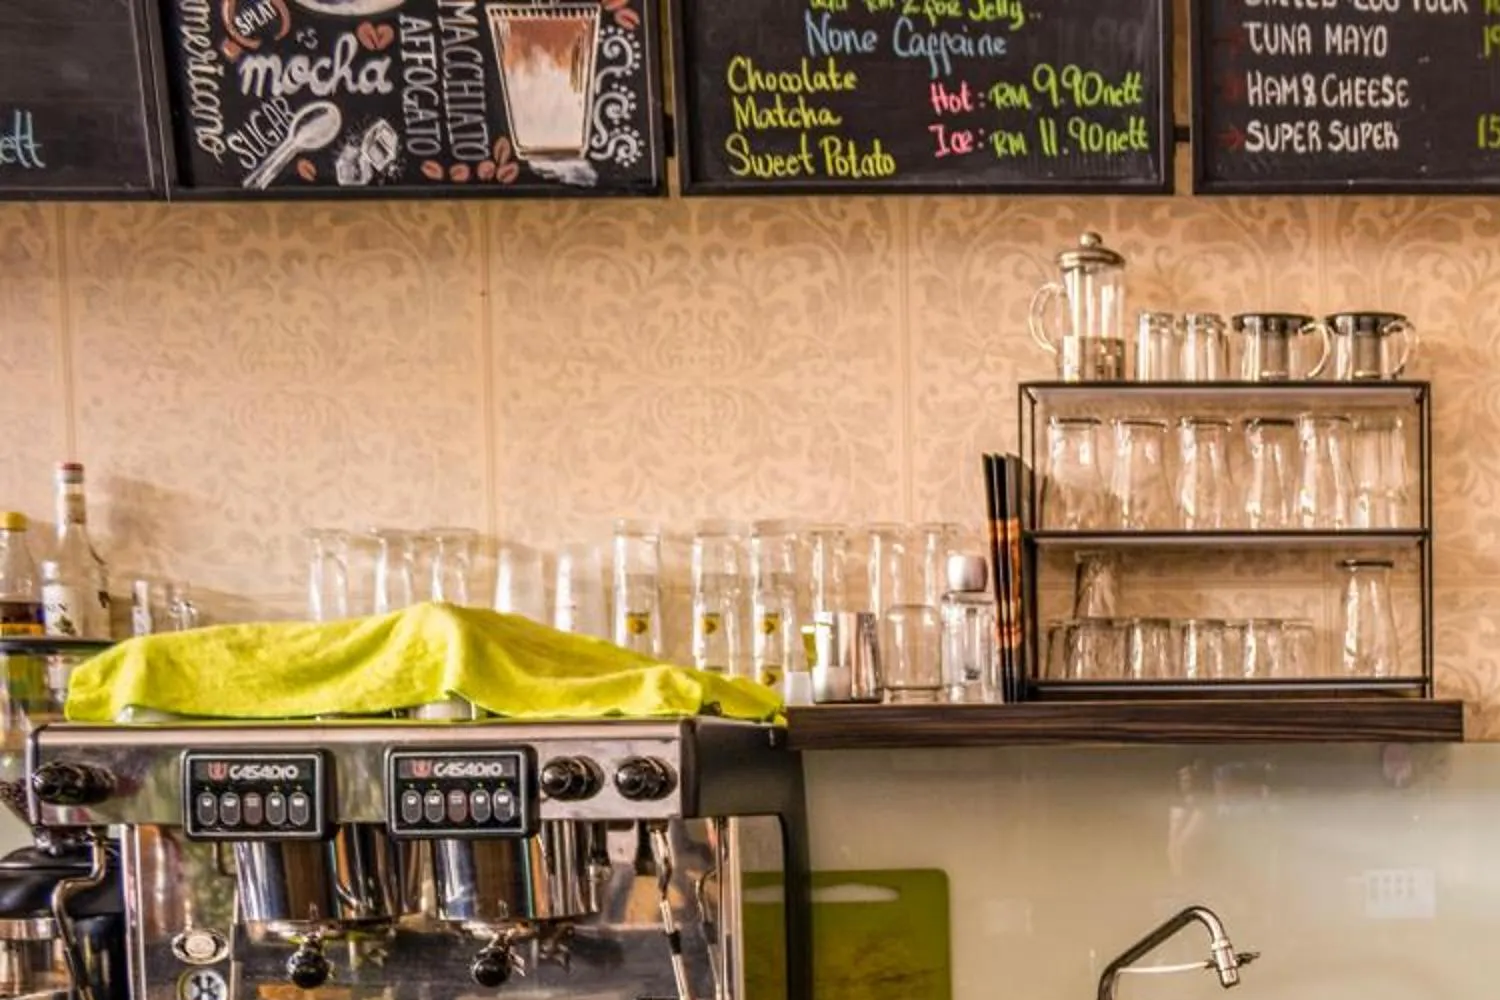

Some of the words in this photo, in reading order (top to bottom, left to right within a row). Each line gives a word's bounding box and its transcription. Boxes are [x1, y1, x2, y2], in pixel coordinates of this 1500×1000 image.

[804, 9, 878, 57] None
[1241, 21, 1312, 57] TUNA
[1325, 22, 1388, 58] MAYO
[180, 0, 227, 165] mericano
[239, 32, 394, 97] mocha
[398, 14, 442, 157] AFFOGATO
[437, 0, 491, 161] MACCHIATO
[727, 55, 858, 94] Chocolate
[227, 96, 297, 169] SUGAR
[733, 93, 842, 131] Matcha
[725, 132, 815, 178] Sweet
[819, 135, 896, 178] Potato
[1245, 119, 1322, 153] SUPER
[1327, 119, 1400, 152] SUPER
[228, 763, 299, 780] CASADIO
[433, 762, 504, 779] CASADIO
